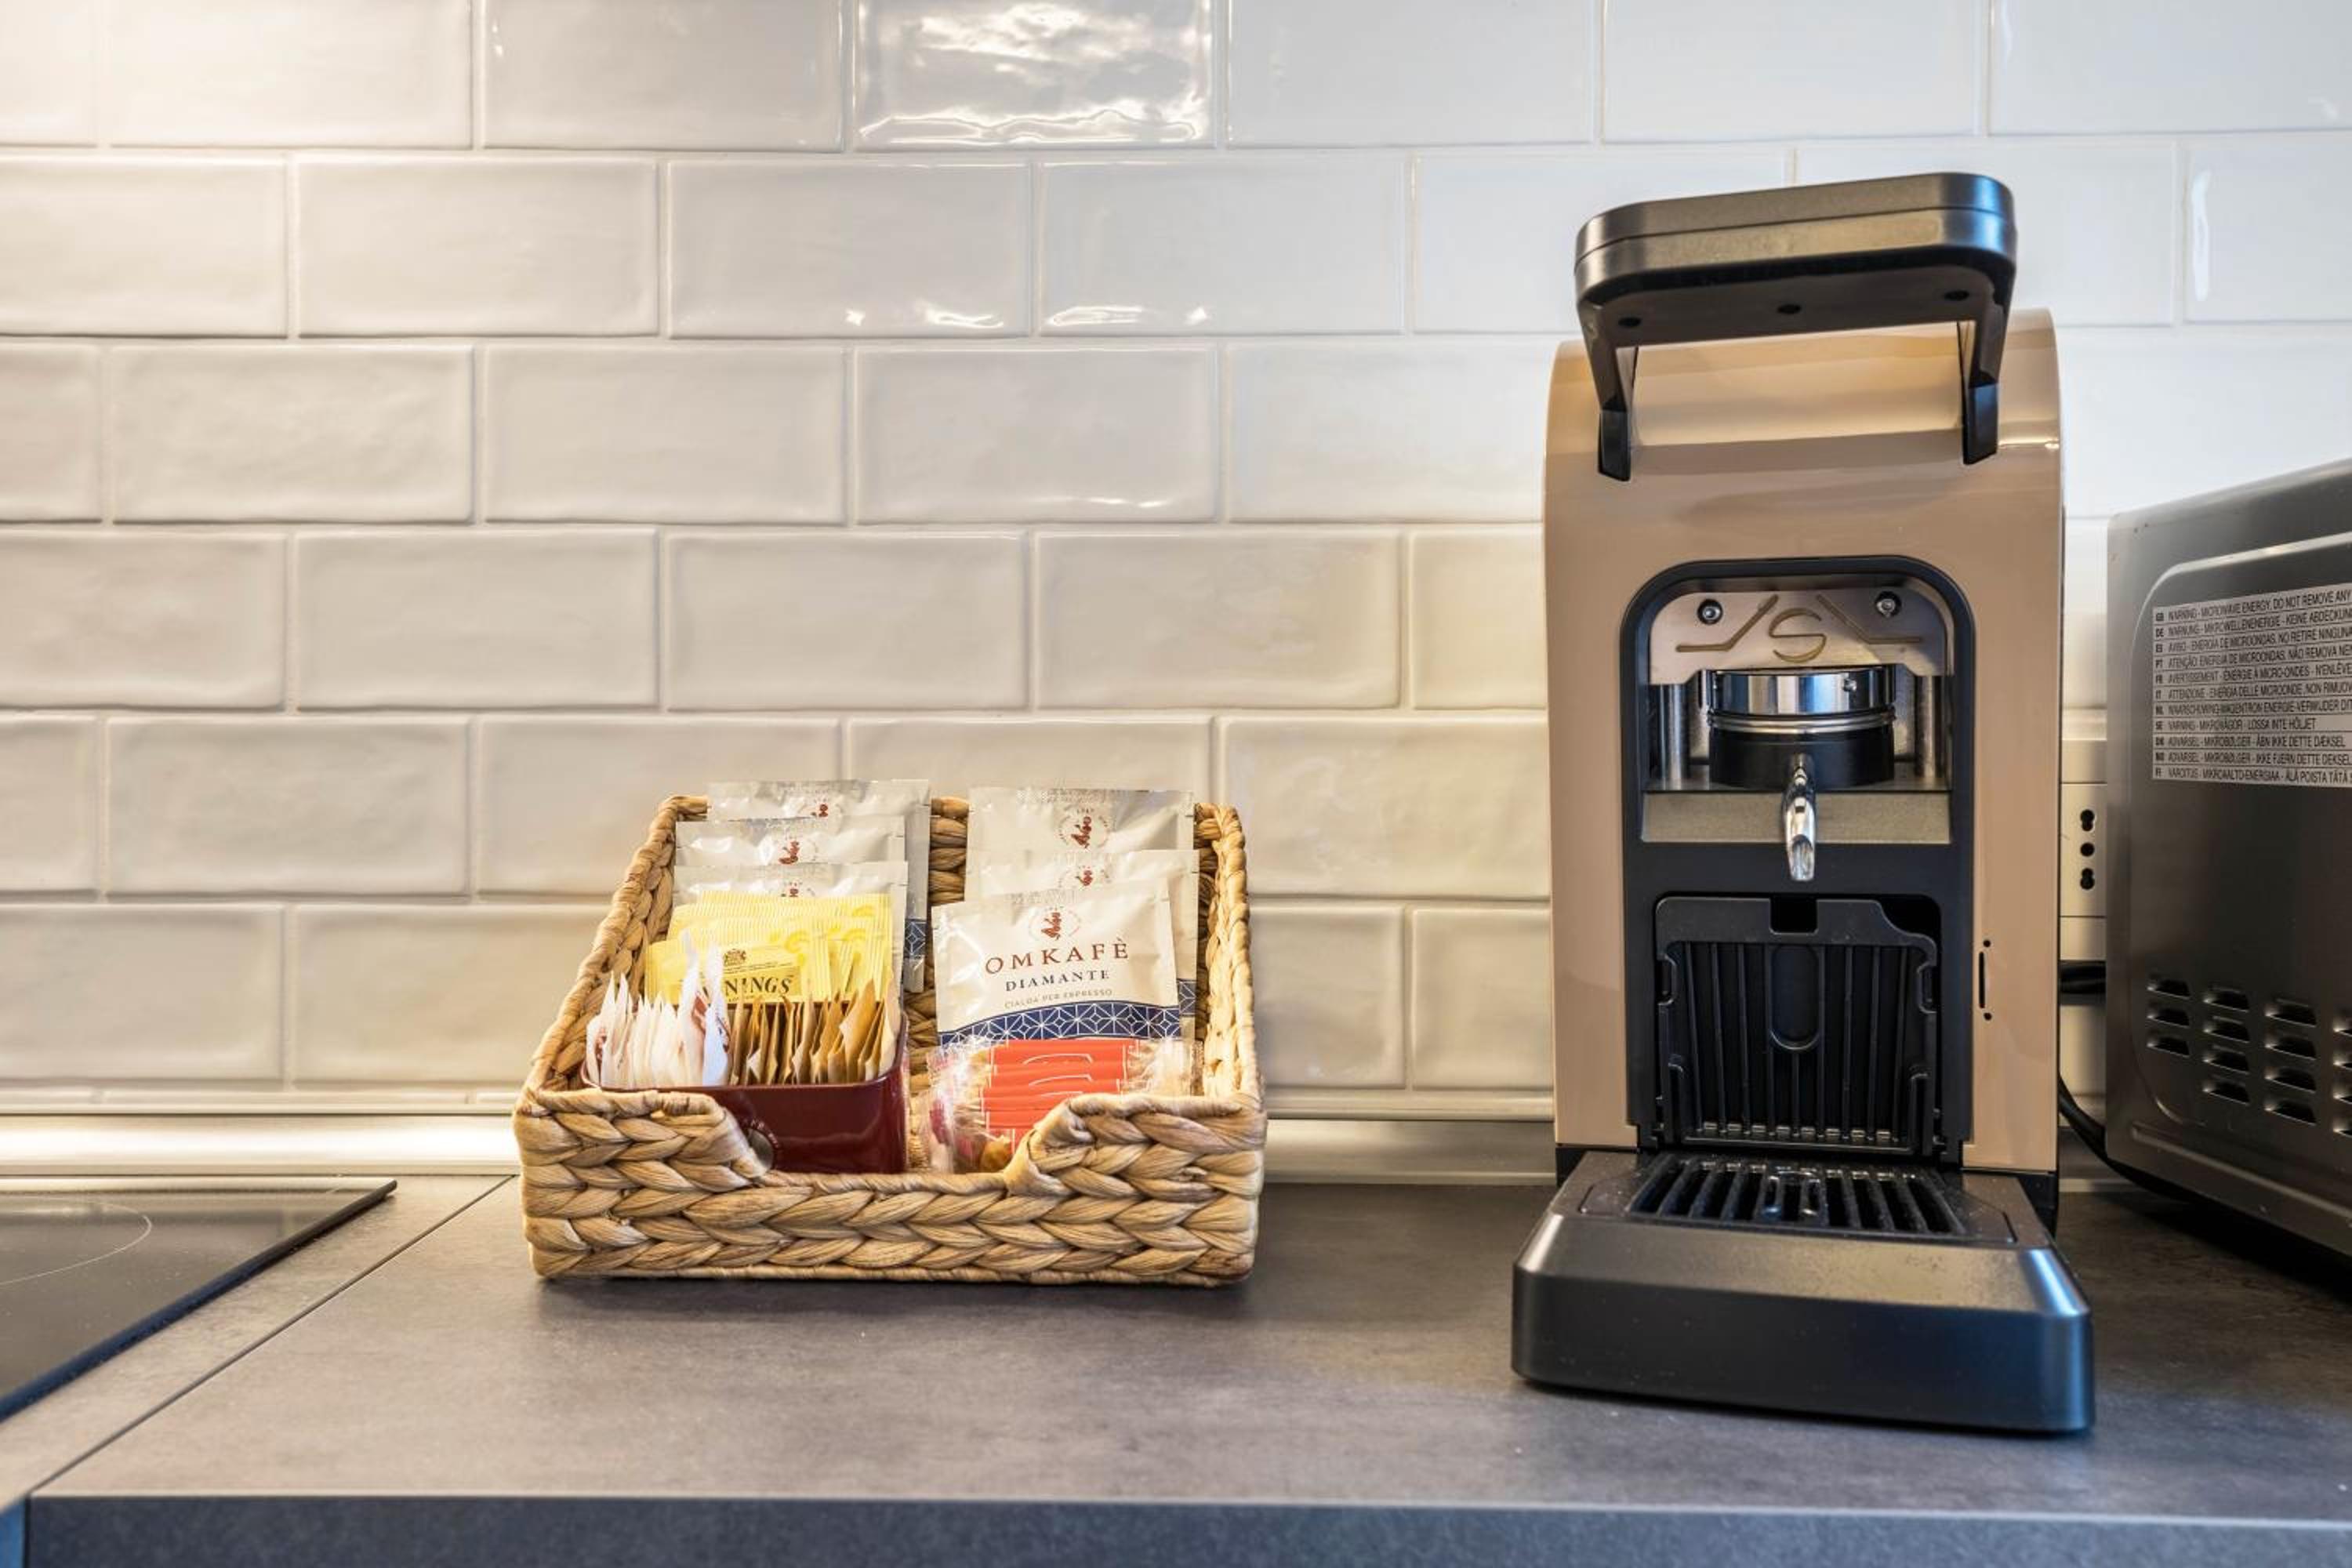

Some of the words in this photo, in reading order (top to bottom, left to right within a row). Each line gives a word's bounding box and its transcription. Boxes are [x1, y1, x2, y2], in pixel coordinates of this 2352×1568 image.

[2274, 598, 2284, 609] DO
[2285, 595, 2300, 608] NOT
[2303, 591, 2333, 605] REMOVE
[2336, 590, 2350, 602] ANY
[2156, 628, 2164, 637] DE
[2285, 612, 2308, 626] KEINE
[2220, 637, 2229, 648] DE
[2278, 631, 2289, 643] NO
[2291, 629, 2318, 642] RETIRE
[2306, 645, 2336, 659] REMOVA
[2306, 682, 2321, 695] NON
[2248, 718, 2270, 730] LOSSA
[2272, 718, 2287, 730] INTE
[2271, 736, 2288, 747] IKKE
[2289, 735, 2312, 747] DETTE
[2256, 753, 2271, 764] IKKE
[2296, 754, 2320, 765] DETTE
[2300, 771, 2327, 783] POISTA
[985, 937, 1128, 975] OMKAFÈ
[1006, 970, 1110, 992] DIAMANTE
[1042, 993, 1059, 1002] PER
[1063, 989, 1112, 999] ESPRESSO
